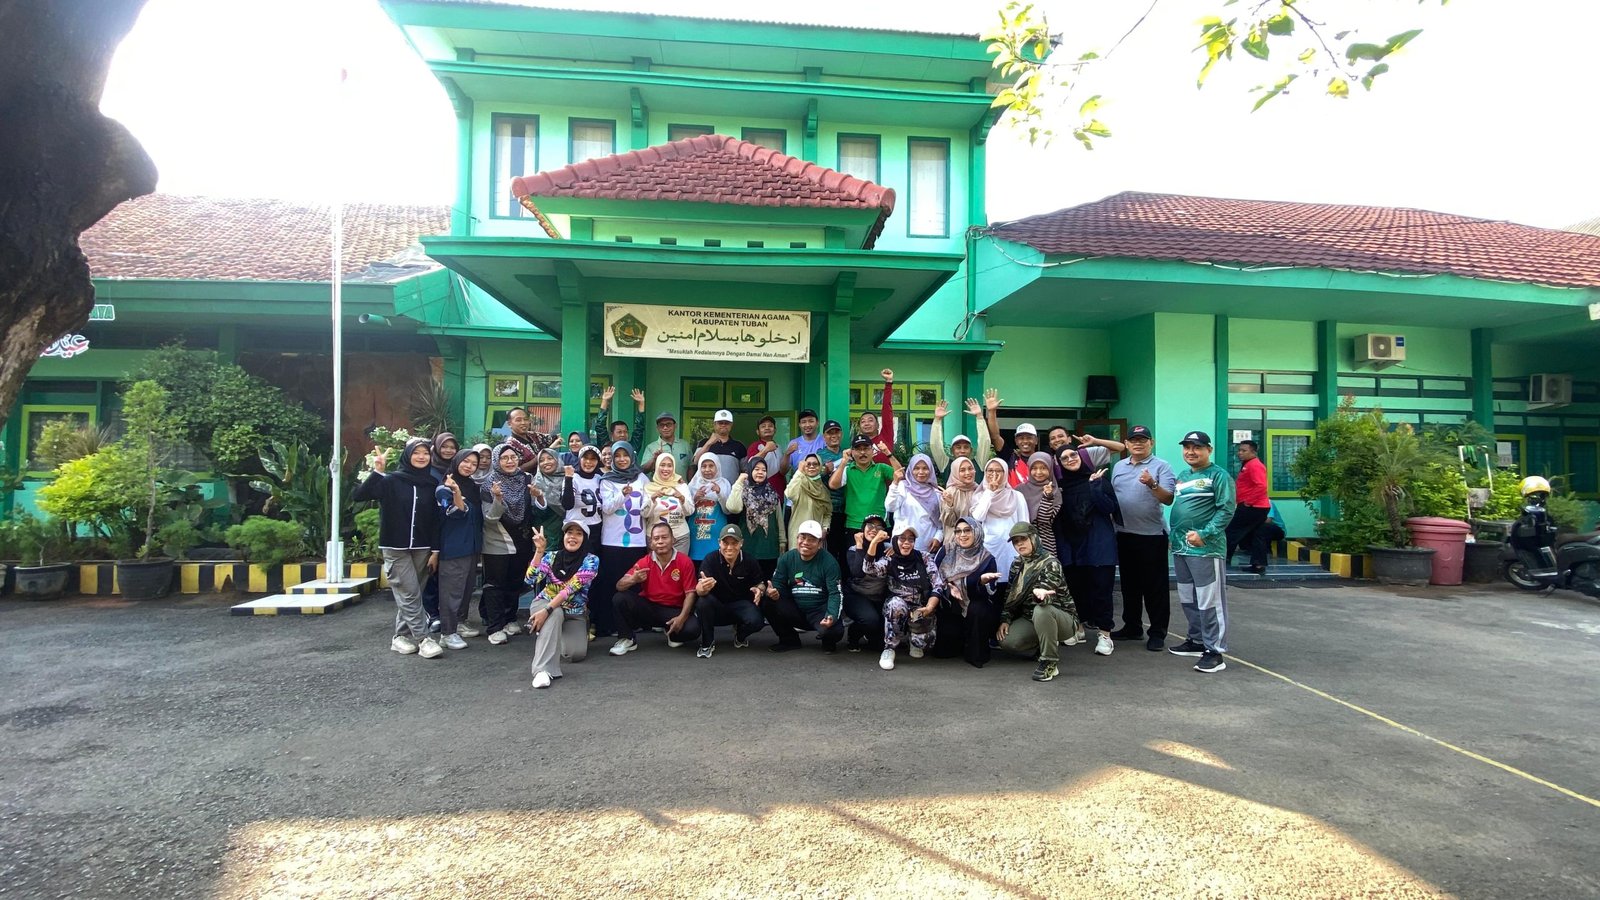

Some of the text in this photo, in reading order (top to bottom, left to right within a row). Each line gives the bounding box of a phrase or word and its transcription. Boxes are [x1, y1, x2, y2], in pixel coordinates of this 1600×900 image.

[89, 305, 115, 320] AYA
[703, 311, 760, 320] KEMENTERIAN
[761, 313, 790, 321] AGAMA
[691, 319, 768, 328] KABUPATEN TUBAN
[726, 350, 746, 358] Dengan
